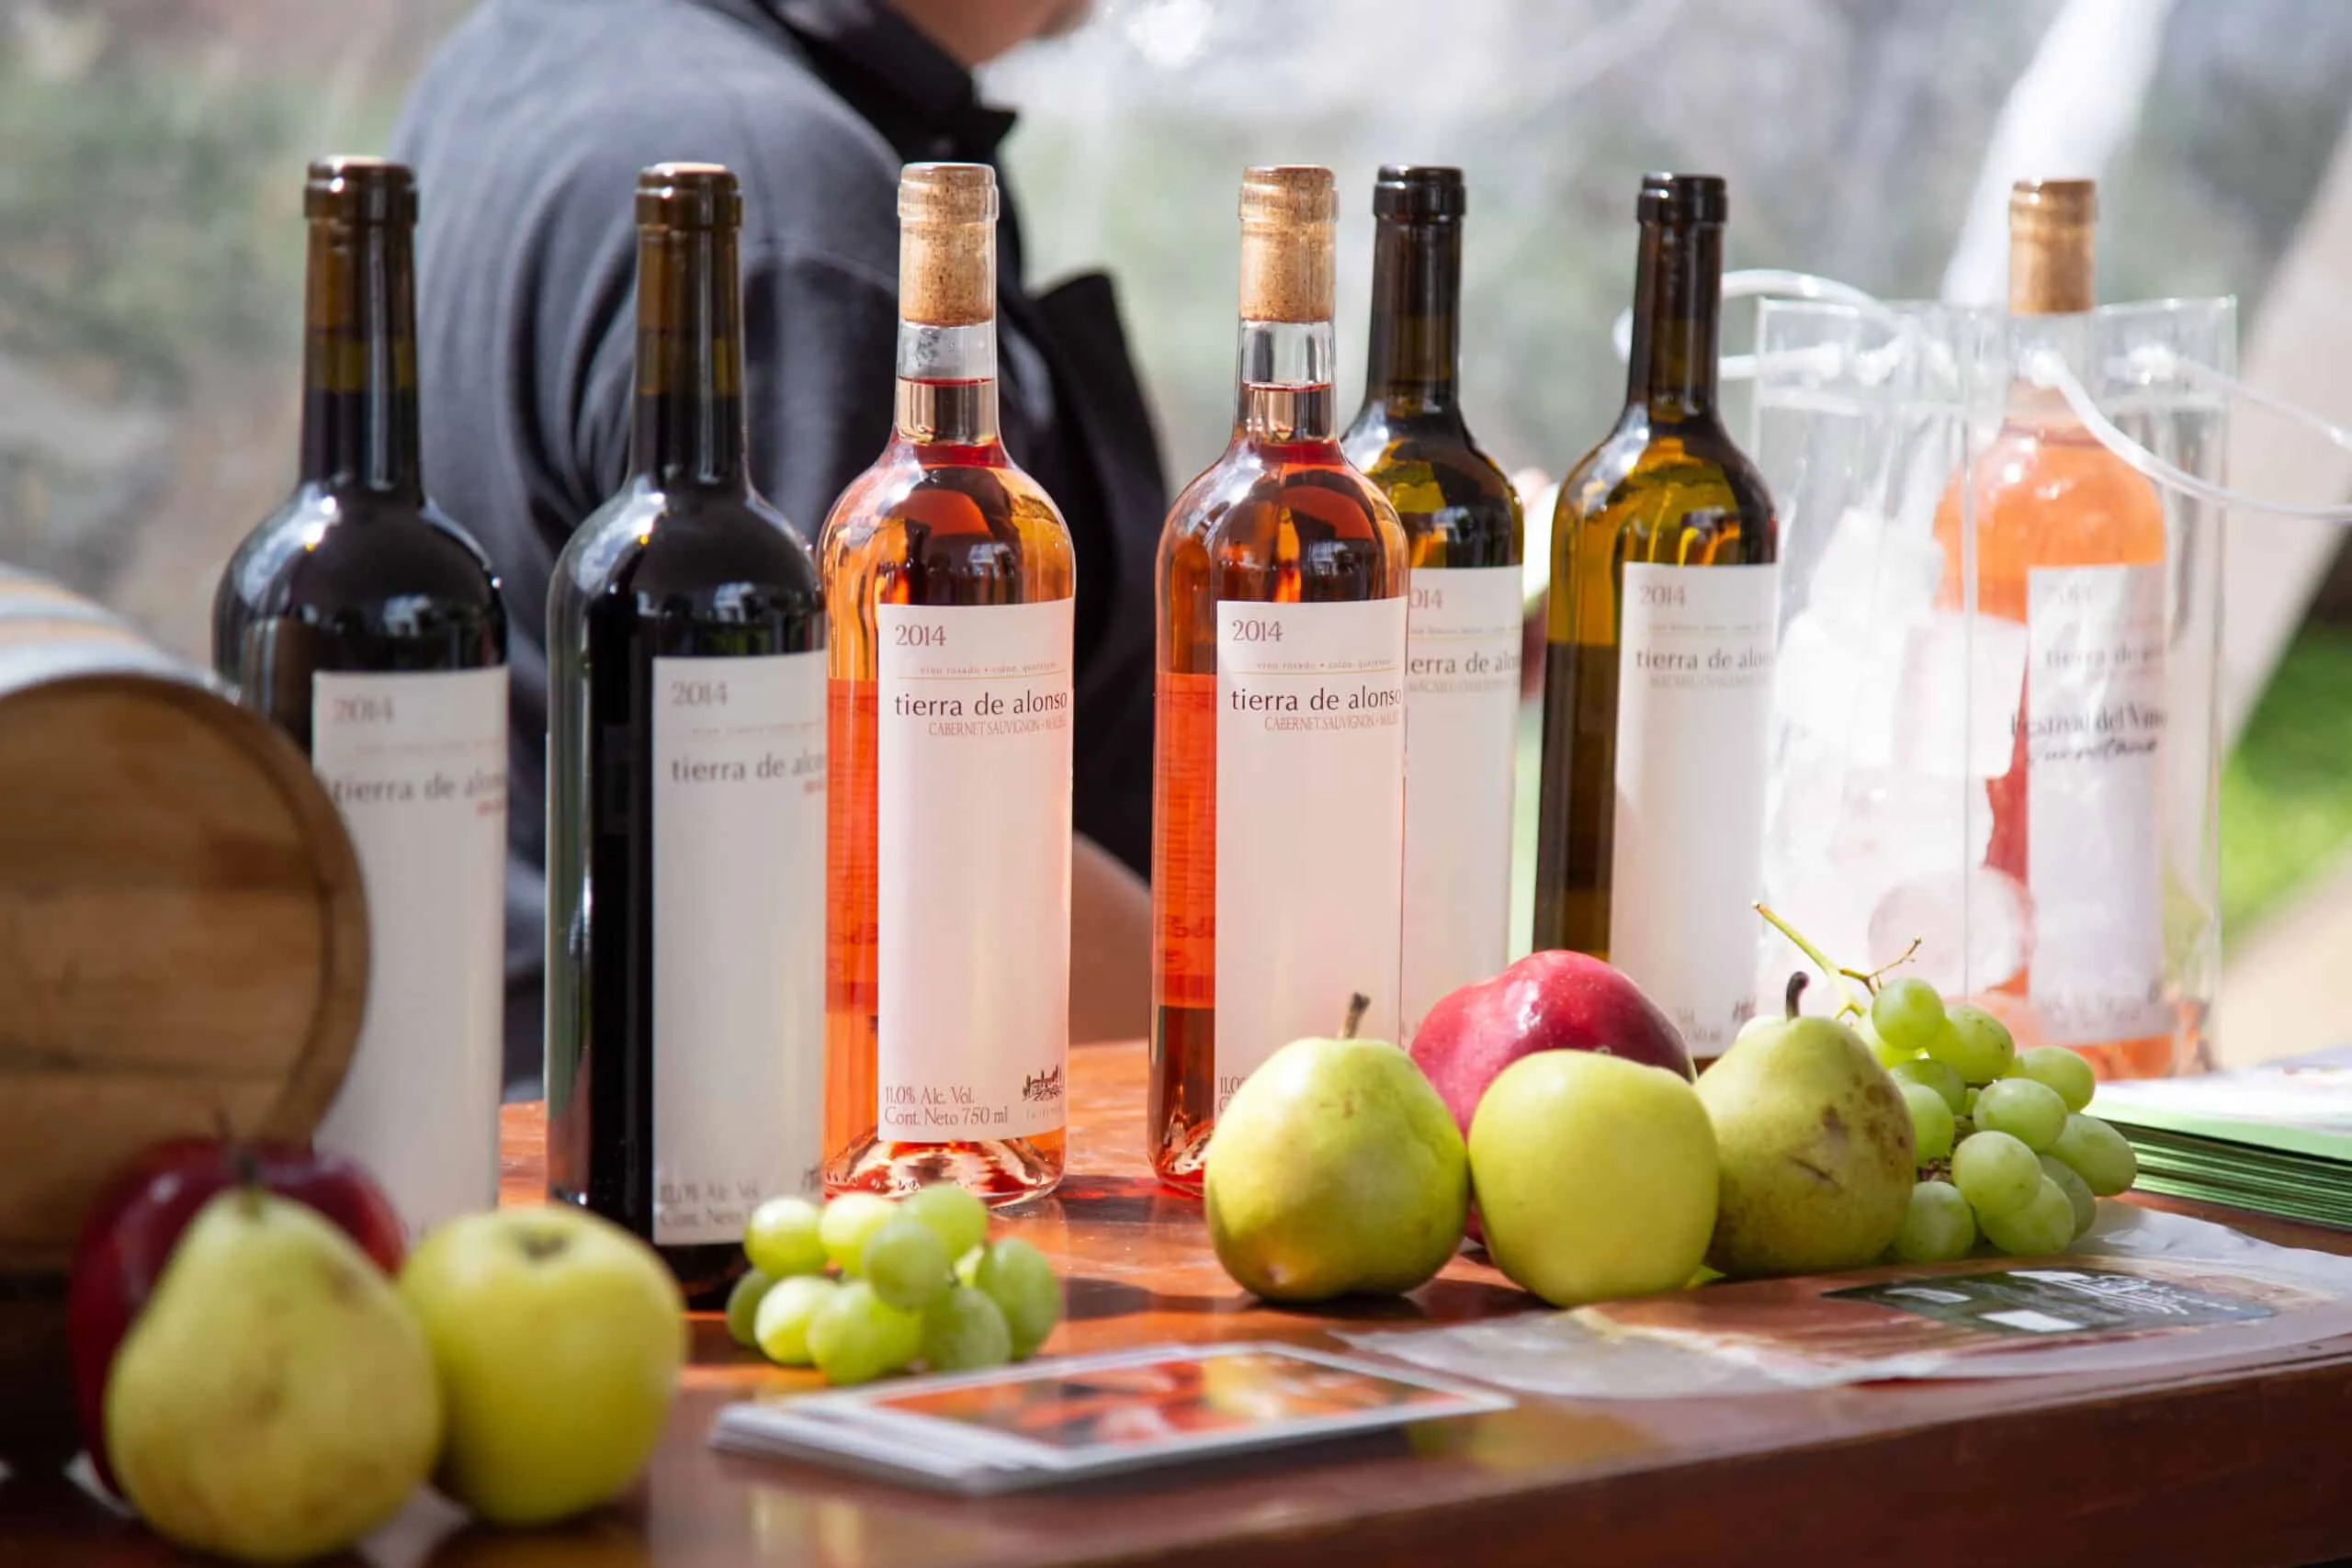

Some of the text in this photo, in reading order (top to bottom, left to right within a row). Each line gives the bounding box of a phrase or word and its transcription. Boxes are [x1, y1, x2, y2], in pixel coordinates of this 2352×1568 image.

[1409, 588, 1443, 609] 014
[1640, 585, 1687, 606] 2014
[895, 625, 946, 647] 2014
[1232, 619, 1283, 642] 2014
[1411, 658, 1456, 674] erra
[1465, 651, 1489, 674] de
[1636, 647, 1698, 669] tierra
[1707, 647, 1732, 669] de
[671, 682, 728, 706] 2014
[895, 690, 1068, 716] tierra de alonso
[1231, 685, 1402, 712] tierra de alonso
[929, 718, 987, 737] CABERNET
[988, 717, 1039, 736] SAUVIGNON
[1264, 715, 1320, 732] CABERNET
[671, 755, 746, 784] tierra
[756, 751, 786, 779] de
[885, 1086, 975, 1104] 11.0% Alc. Vol.
[885, 1106, 919, 1125] Cont.
[924, 1107, 958, 1125] Neto
[963, 1106, 989, 1125] 750
[993, 1106, 1009, 1124] ml
